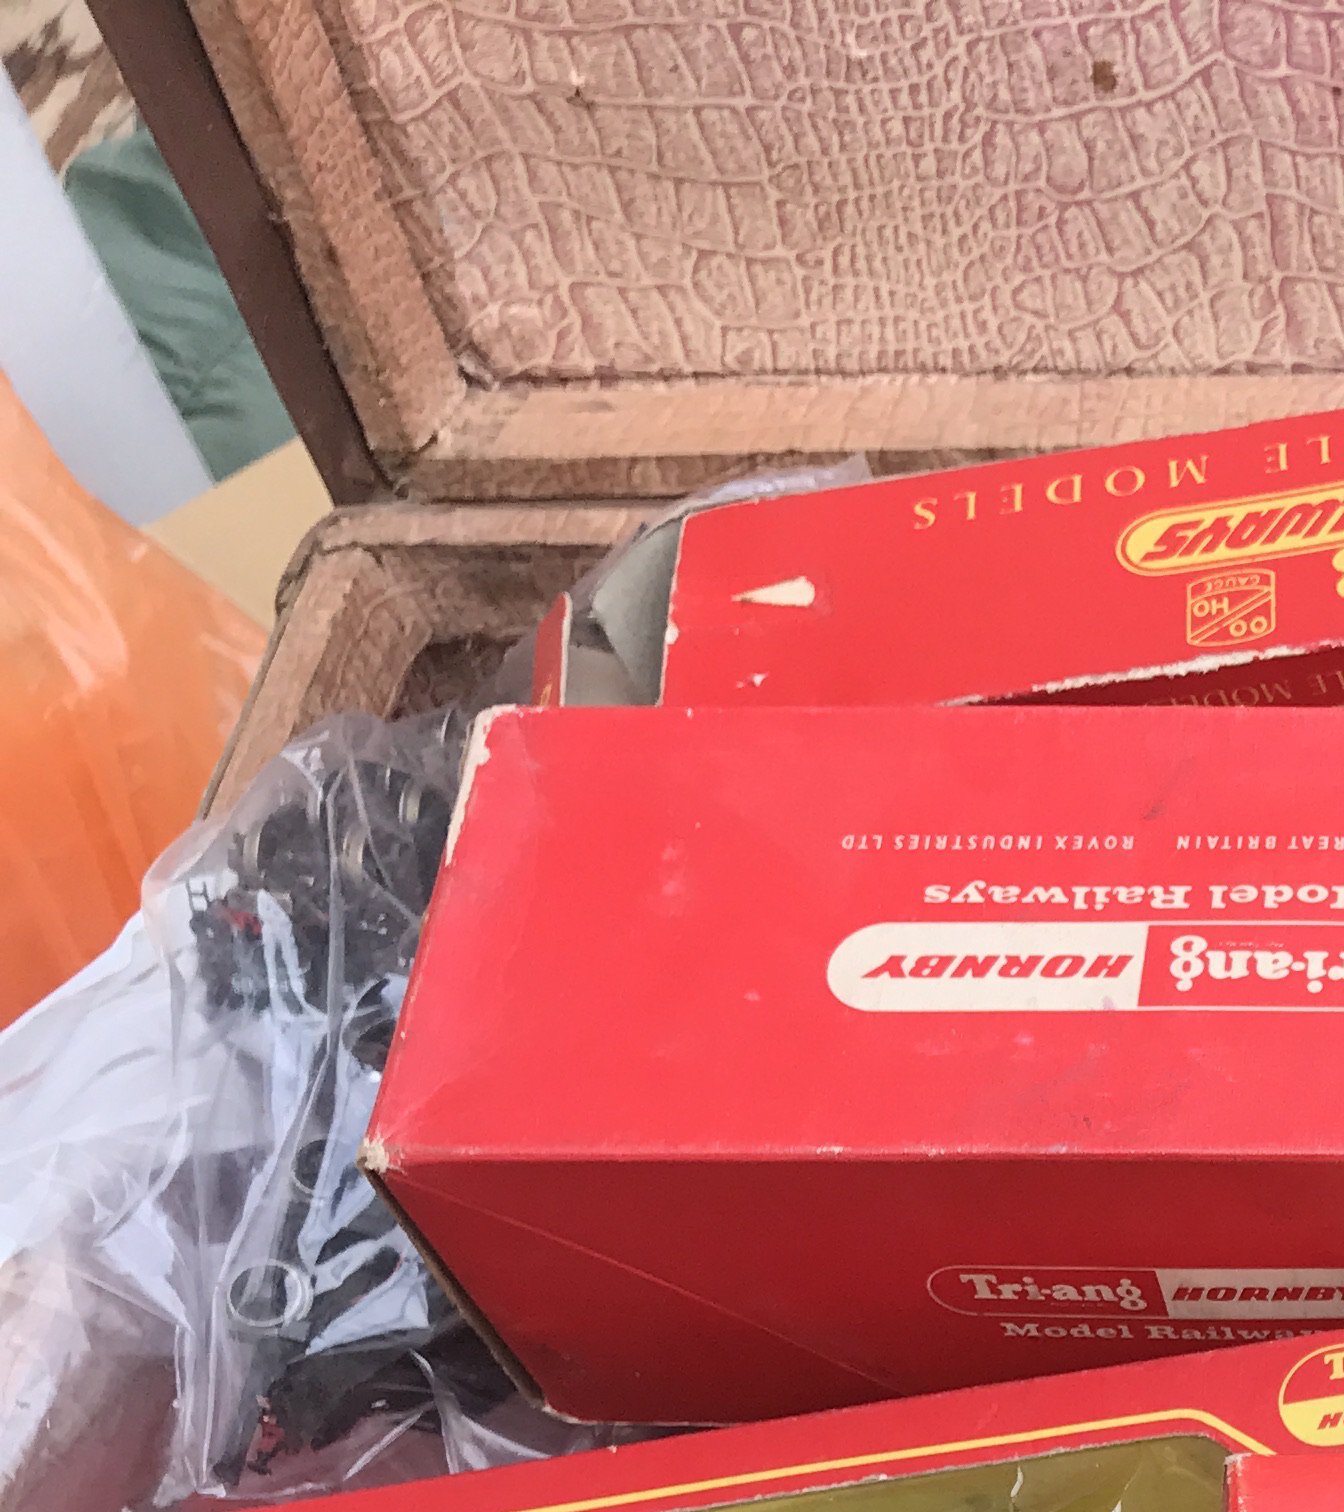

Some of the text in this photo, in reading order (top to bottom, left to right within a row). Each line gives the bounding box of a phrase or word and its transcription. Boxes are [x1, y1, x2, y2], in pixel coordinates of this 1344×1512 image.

[913, 455, 1208, 529] MODELS
[1193, 597, 1230, 618] HO
[842, 834, 882, 849] LTD
[894, 834, 1042, 850] INDUSTRIES
[1053, 835, 1135, 851] ROVEX
[1177, 836, 1277, 851] BRITAIN
[925, 883, 1190, 910] Railways
[861, 955, 1134, 979] HORNBY
[959, 1273, 1148, 1312] Tri-ang
[1000, 1322, 1135, 1339] Model
